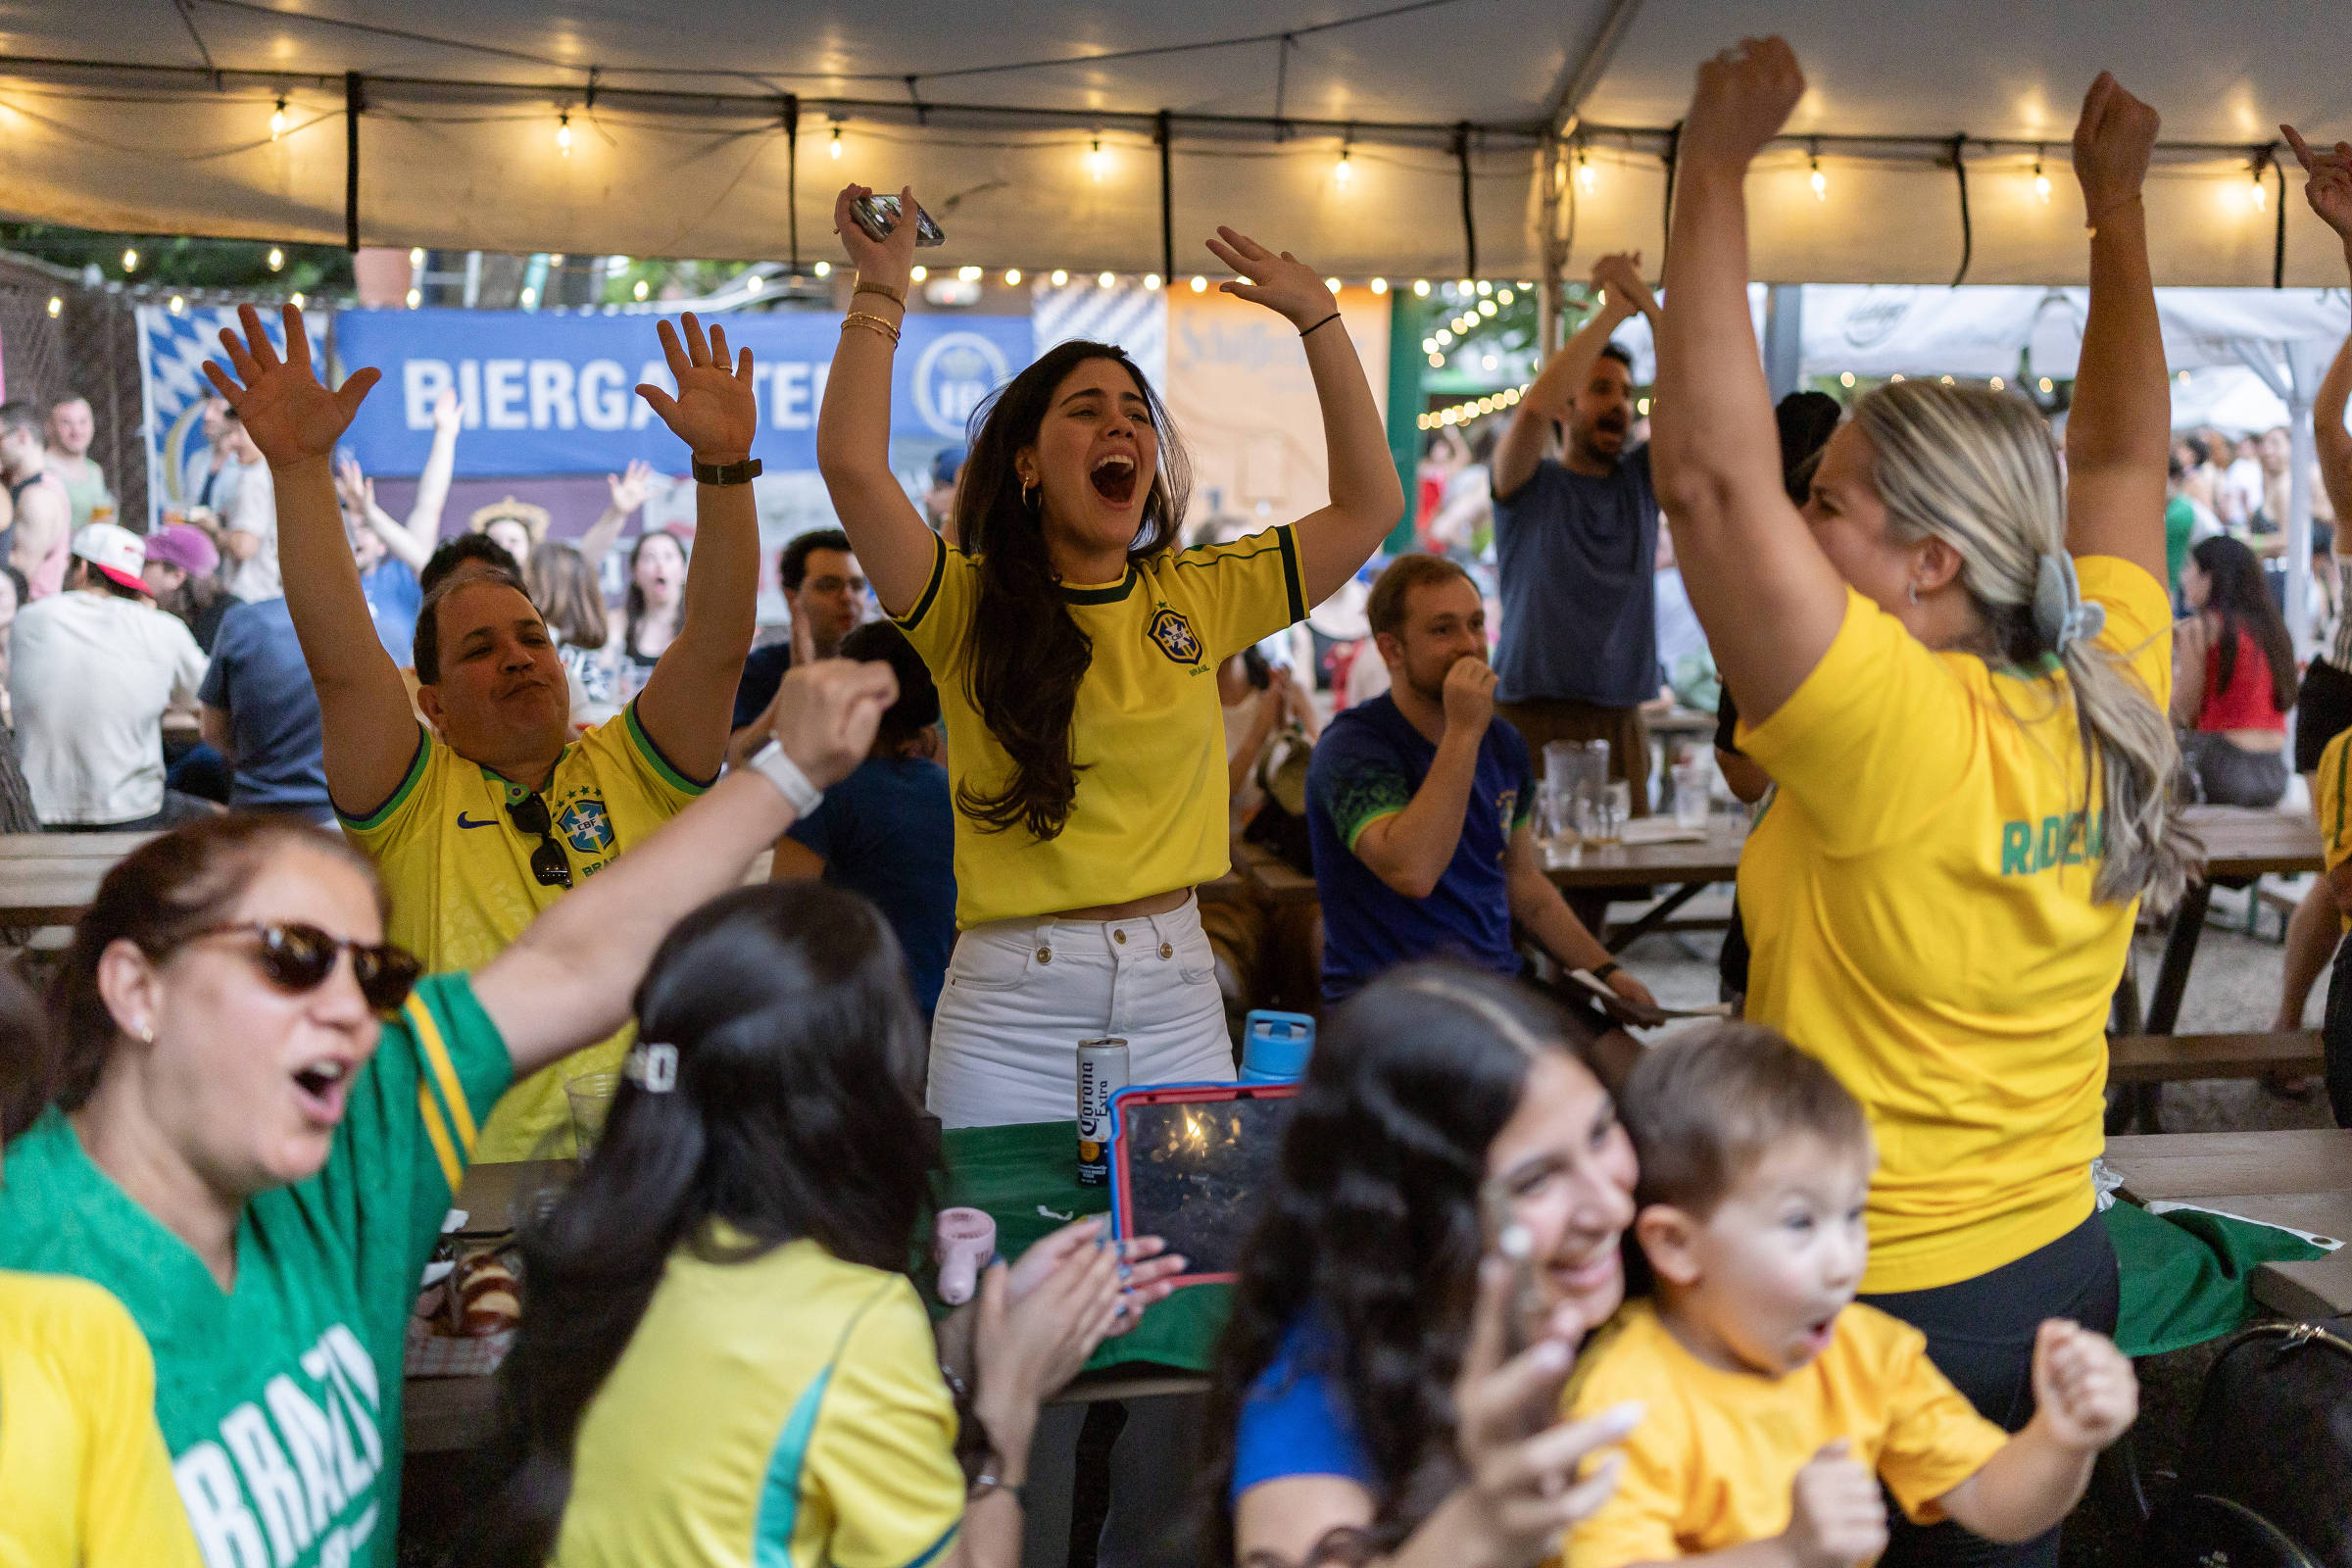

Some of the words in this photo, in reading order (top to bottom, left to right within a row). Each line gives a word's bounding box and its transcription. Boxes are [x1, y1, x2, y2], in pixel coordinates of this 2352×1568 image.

[403, 358, 833, 431] BIERGAE
[576, 819, 598, 832] CBF
[1080, 1062, 1098, 1137] Corona
[1095, 1080, 1108, 1117] Extra
